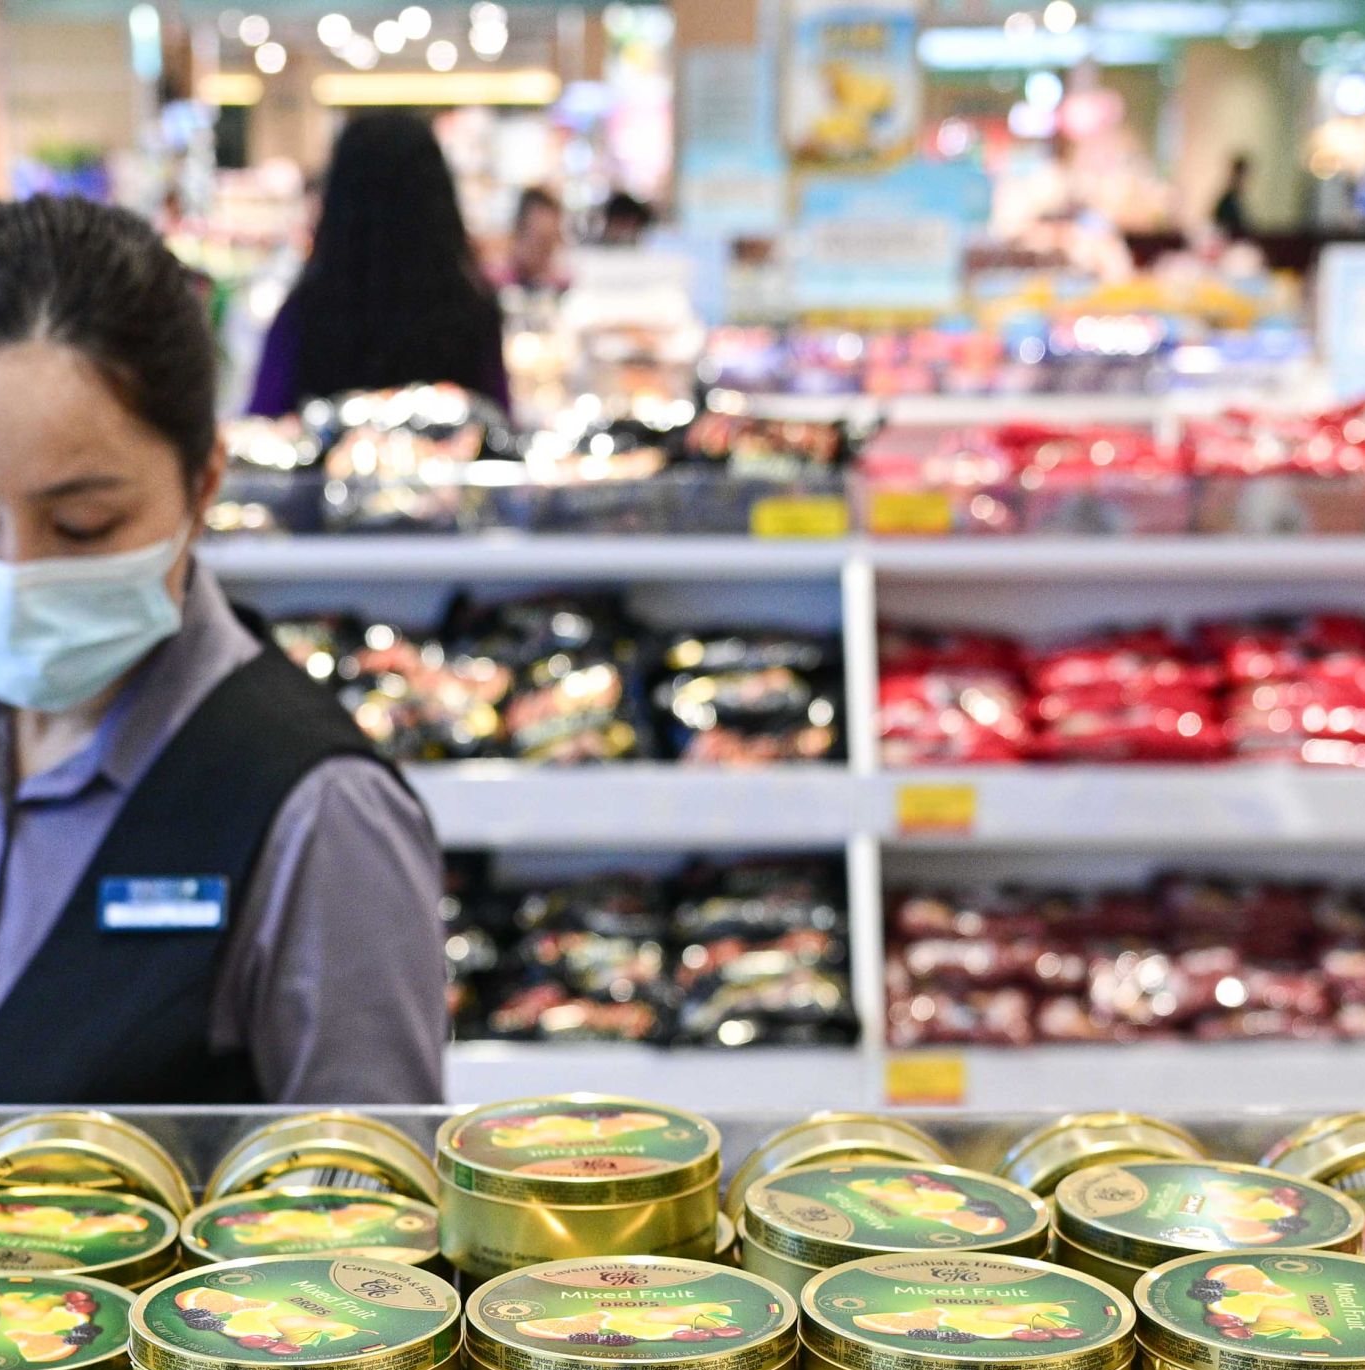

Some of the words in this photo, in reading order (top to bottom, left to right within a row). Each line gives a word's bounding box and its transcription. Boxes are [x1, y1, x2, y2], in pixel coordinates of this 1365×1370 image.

[560, 1288, 629, 1300] Mixed
[636, 1288, 695, 1300] Fruit
[894, 1285, 962, 1297] Mixed
[969, 1286, 1029, 1298] Fruit
[290, 1279, 337, 1311] Mixed
[335, 1296, 378, 1320] Fruit
[600, 1299, 659, 1308] DROPS
[934, 1297, 995, 1306] DROPS
[288, 1296, 331, 1316] DROPS
